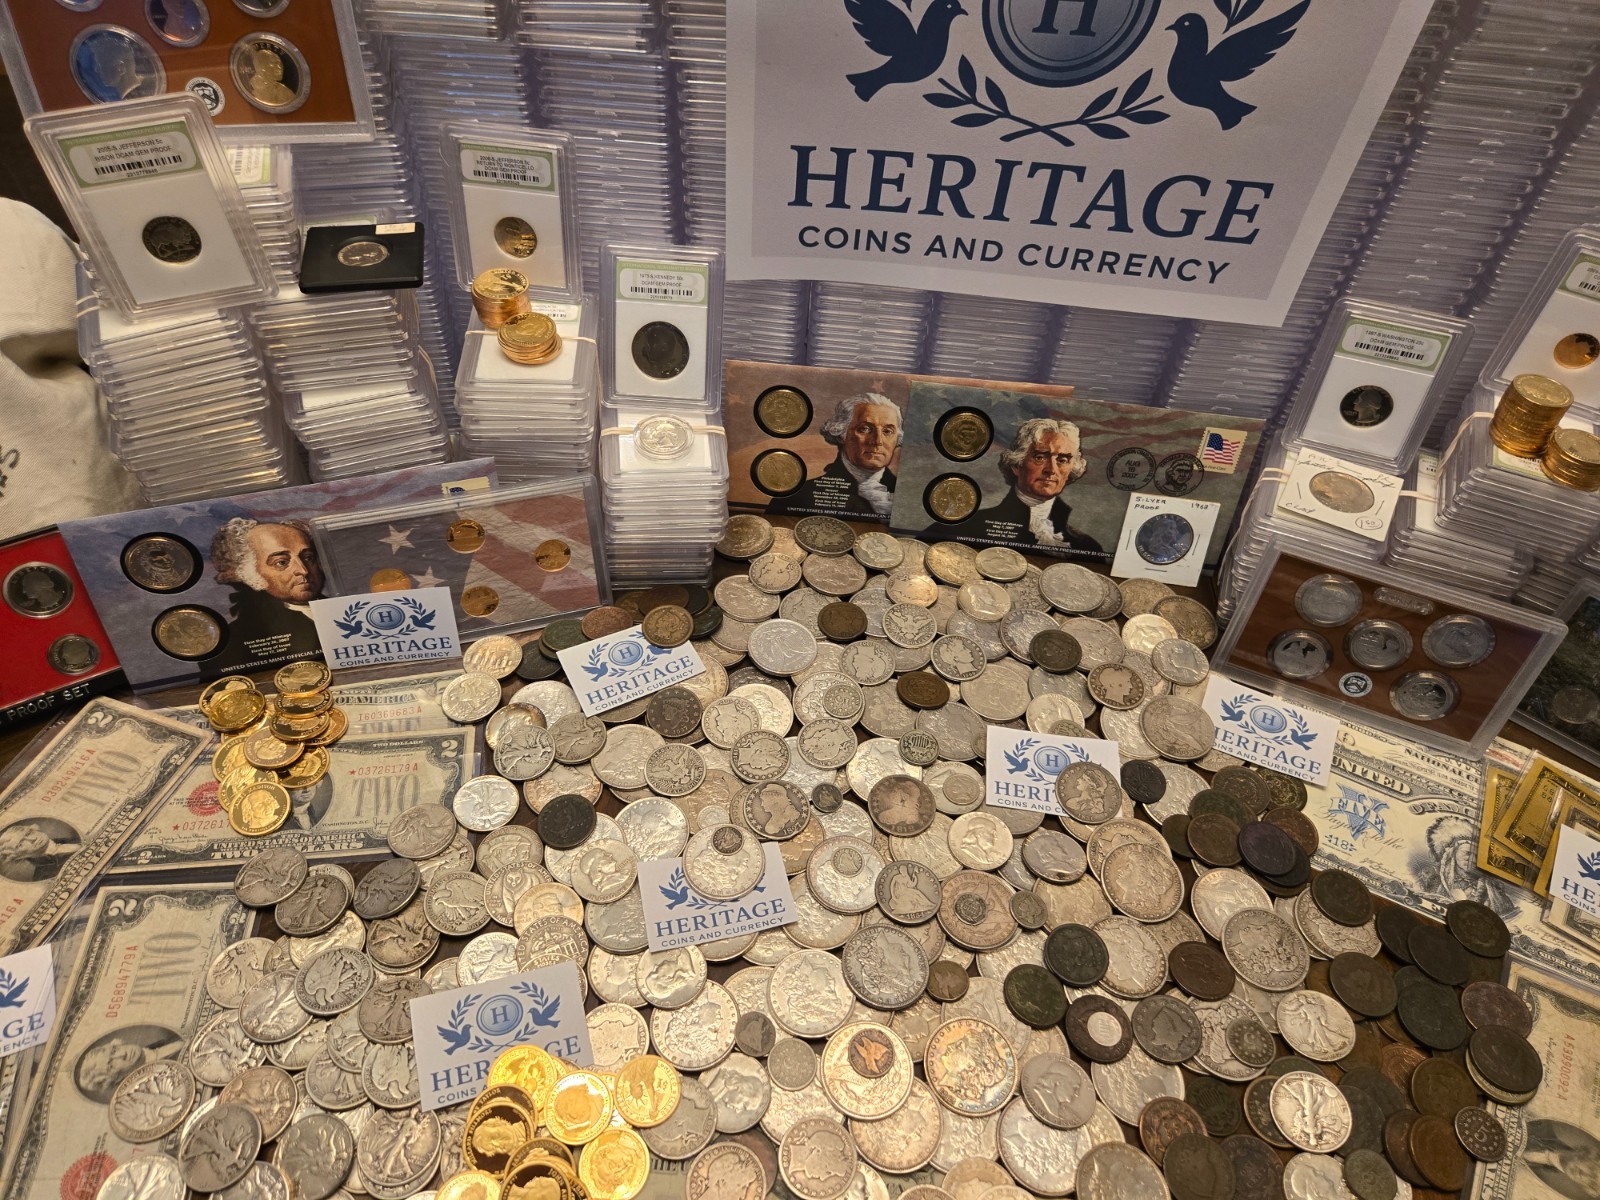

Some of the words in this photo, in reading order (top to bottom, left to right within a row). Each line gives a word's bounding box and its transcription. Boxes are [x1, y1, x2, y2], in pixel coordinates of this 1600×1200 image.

[116, 151, 134, 159] DCAM
[150, 146, 172, 154] PROOF
[118, 140, 155, 151] JEFFERSON
[788, 144, 1274, 245] HERITAGE
[798, 225, 911, 254] COINS
[924, 234, 1003, 262] AND
[1018, 243, 1230, 285] CURRENCY
[1381, 332, 1415, 343] WASHINGTON
[378, 611, 393, 624] H
[333, 636, 452, 660] HERITAGE
[620, 647, 635, 660] H
[221, 664, 245, 673] UNITED
[246, 659, 268, 668] STATES
[286, 651, 315, 660] OFFICIAL
[340, 658, 369, 668] COINS
[370, 655, 395, 665] AND
[397, 650, 451, 661] CURRENCY
[586, 655, 694, 706] HERITAGE
[595, 698, 624, 712] COINS
[626, 689, 645, 701] AND
[646, 669, 694, 692] CURRENCY
[6, 695, 56, 722] PROOF
[62, 684, 91, 701] SET
[86, 710, 114, 728] 2
[1261, 712, 1276, 727] H
[169, 753, 184, 766] 2
[441, 740, 458, 758] 2
[1045, 753, 1059, 768] H
[1236, 750, 1257, 761] AND
[1260, 759, 1316, 782] CURRENCY
[1404, 748, 1463, 777] NATIONAL
[60, 750, 142, 806] TWO
[1332, 755, 1411, 794] UNITED
[352, 773, 421, 818] TWO
[994, 780, 1058, 802] HERI
[997, 798, 1028, 809] COINS
[1031, 803, 1051, 812] AND
[182, 819, 231, 831] 0372617
[213, 840, 257, 851] UNITED
[257, 837, 299, 848] STATES
[300, 836, 310, 845] OF
[309, 832, 366, 844] AMERICA
[210, 849, 260, 860] TWO
[21, 889, 58, 932] UNITED
[54, 859, 84, 894] STATES
[90, 802, 133, 851] AMERICA
[31, 889, 73, 936] TWO
[67, 805, 144, 893] DOLLARS
[109, 898, 138, 917] 2
[1563, 893, 1596, 914] COINS
[655, 898, 786, 937] HERITAGE
[521, 918, 548, 942] STATES
[562, 918, 589, 953] AMERICA
[661, 935, 695, 947] COINS
[699, 931, 722, 941] AND
[725, 916, 784, 935] CURRENCY
[85, 935, 102, 975] DOLLARS
[533, 955, 560, 965] STATES
[128, 931, 201, 1006] TWO
[490, 1005, 510, 1025] H
[430, 1035, 582, 1092] HERGE
[437, 1086, 477, 1104] COINS
[479, 1087, 501, 1106] TAYLOR
[1474, 1125, 1490, 1143] 5
